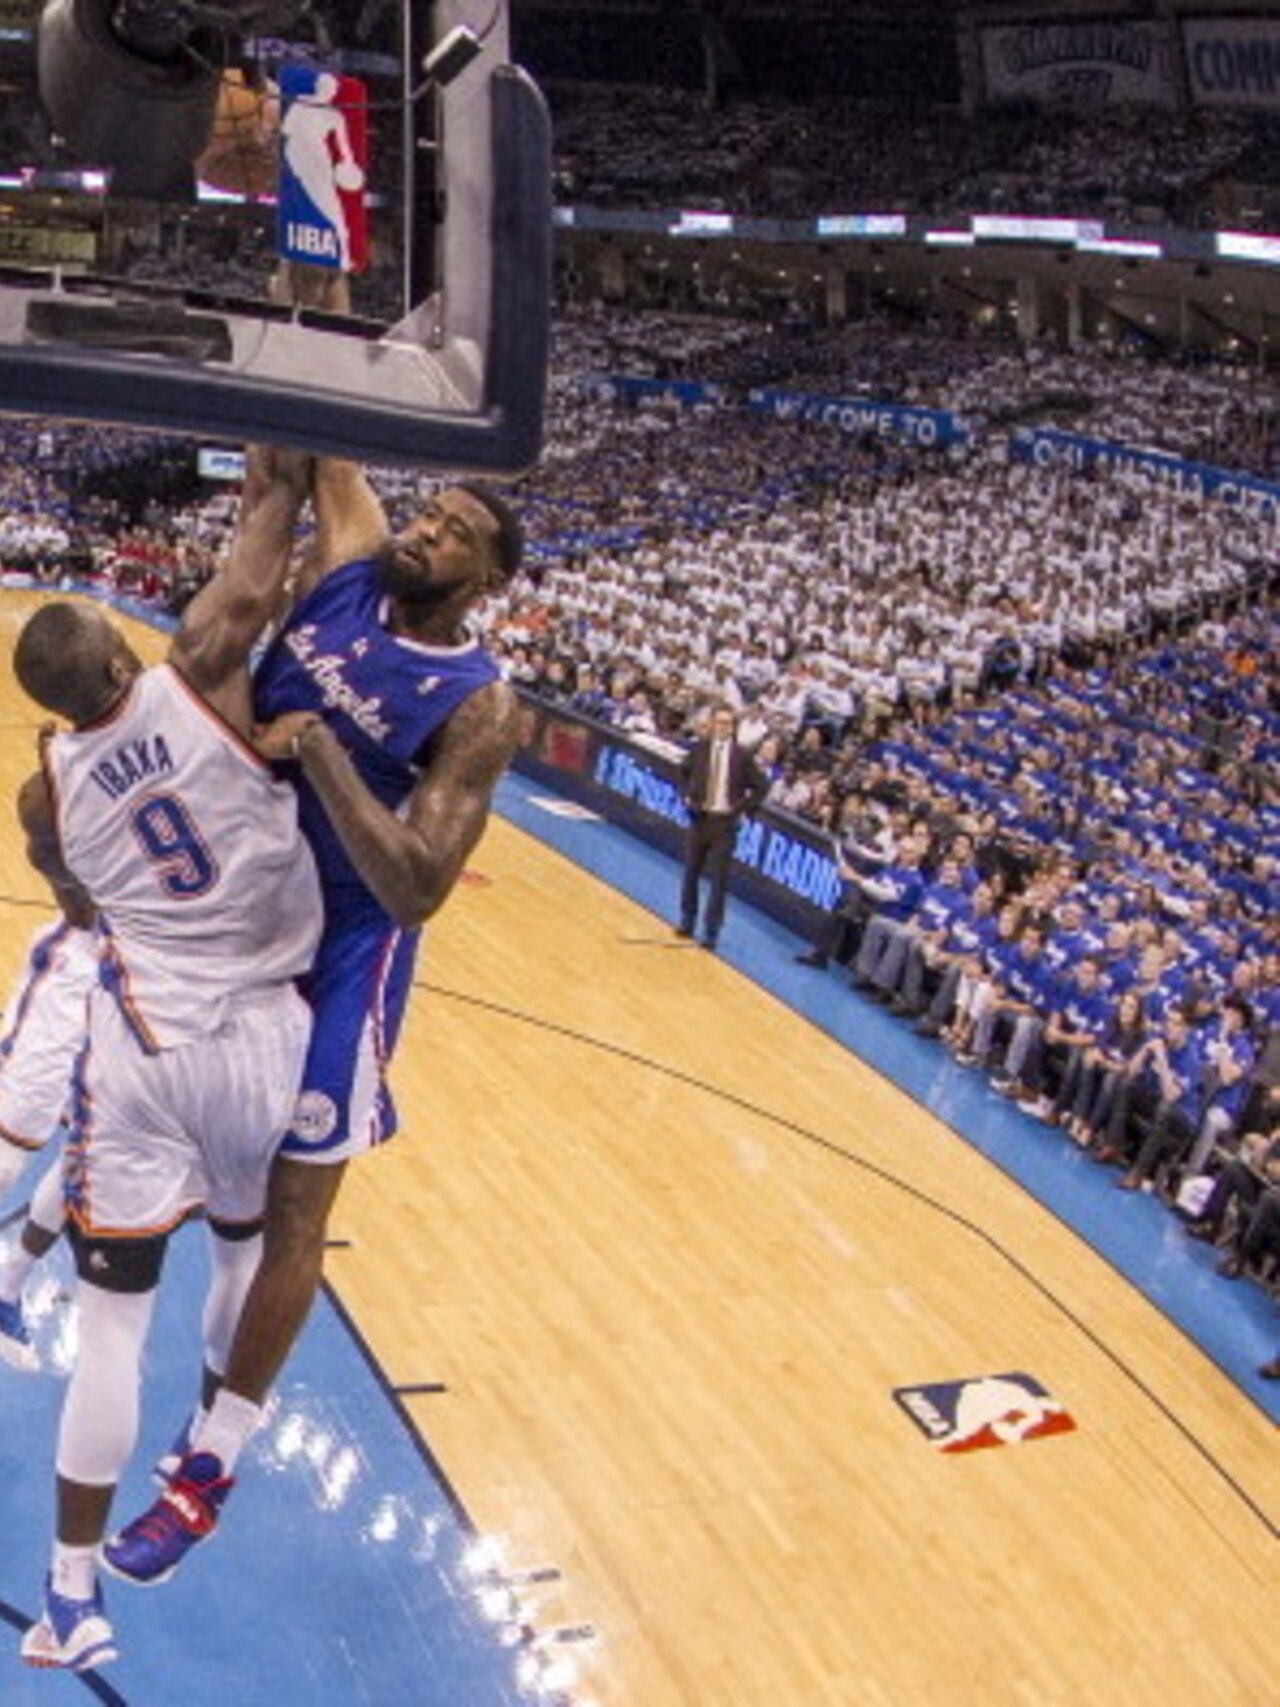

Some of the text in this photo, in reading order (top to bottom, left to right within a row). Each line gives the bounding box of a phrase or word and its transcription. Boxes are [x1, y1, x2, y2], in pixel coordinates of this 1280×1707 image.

[287, 221, 338, 259] NBA
[774, 395, 938, 445] WLCOME TO
[89, 733, 174, 801] IBAKA
[129, 788, 221, 901] 9
[761, 831, 842, 913] RADIO
